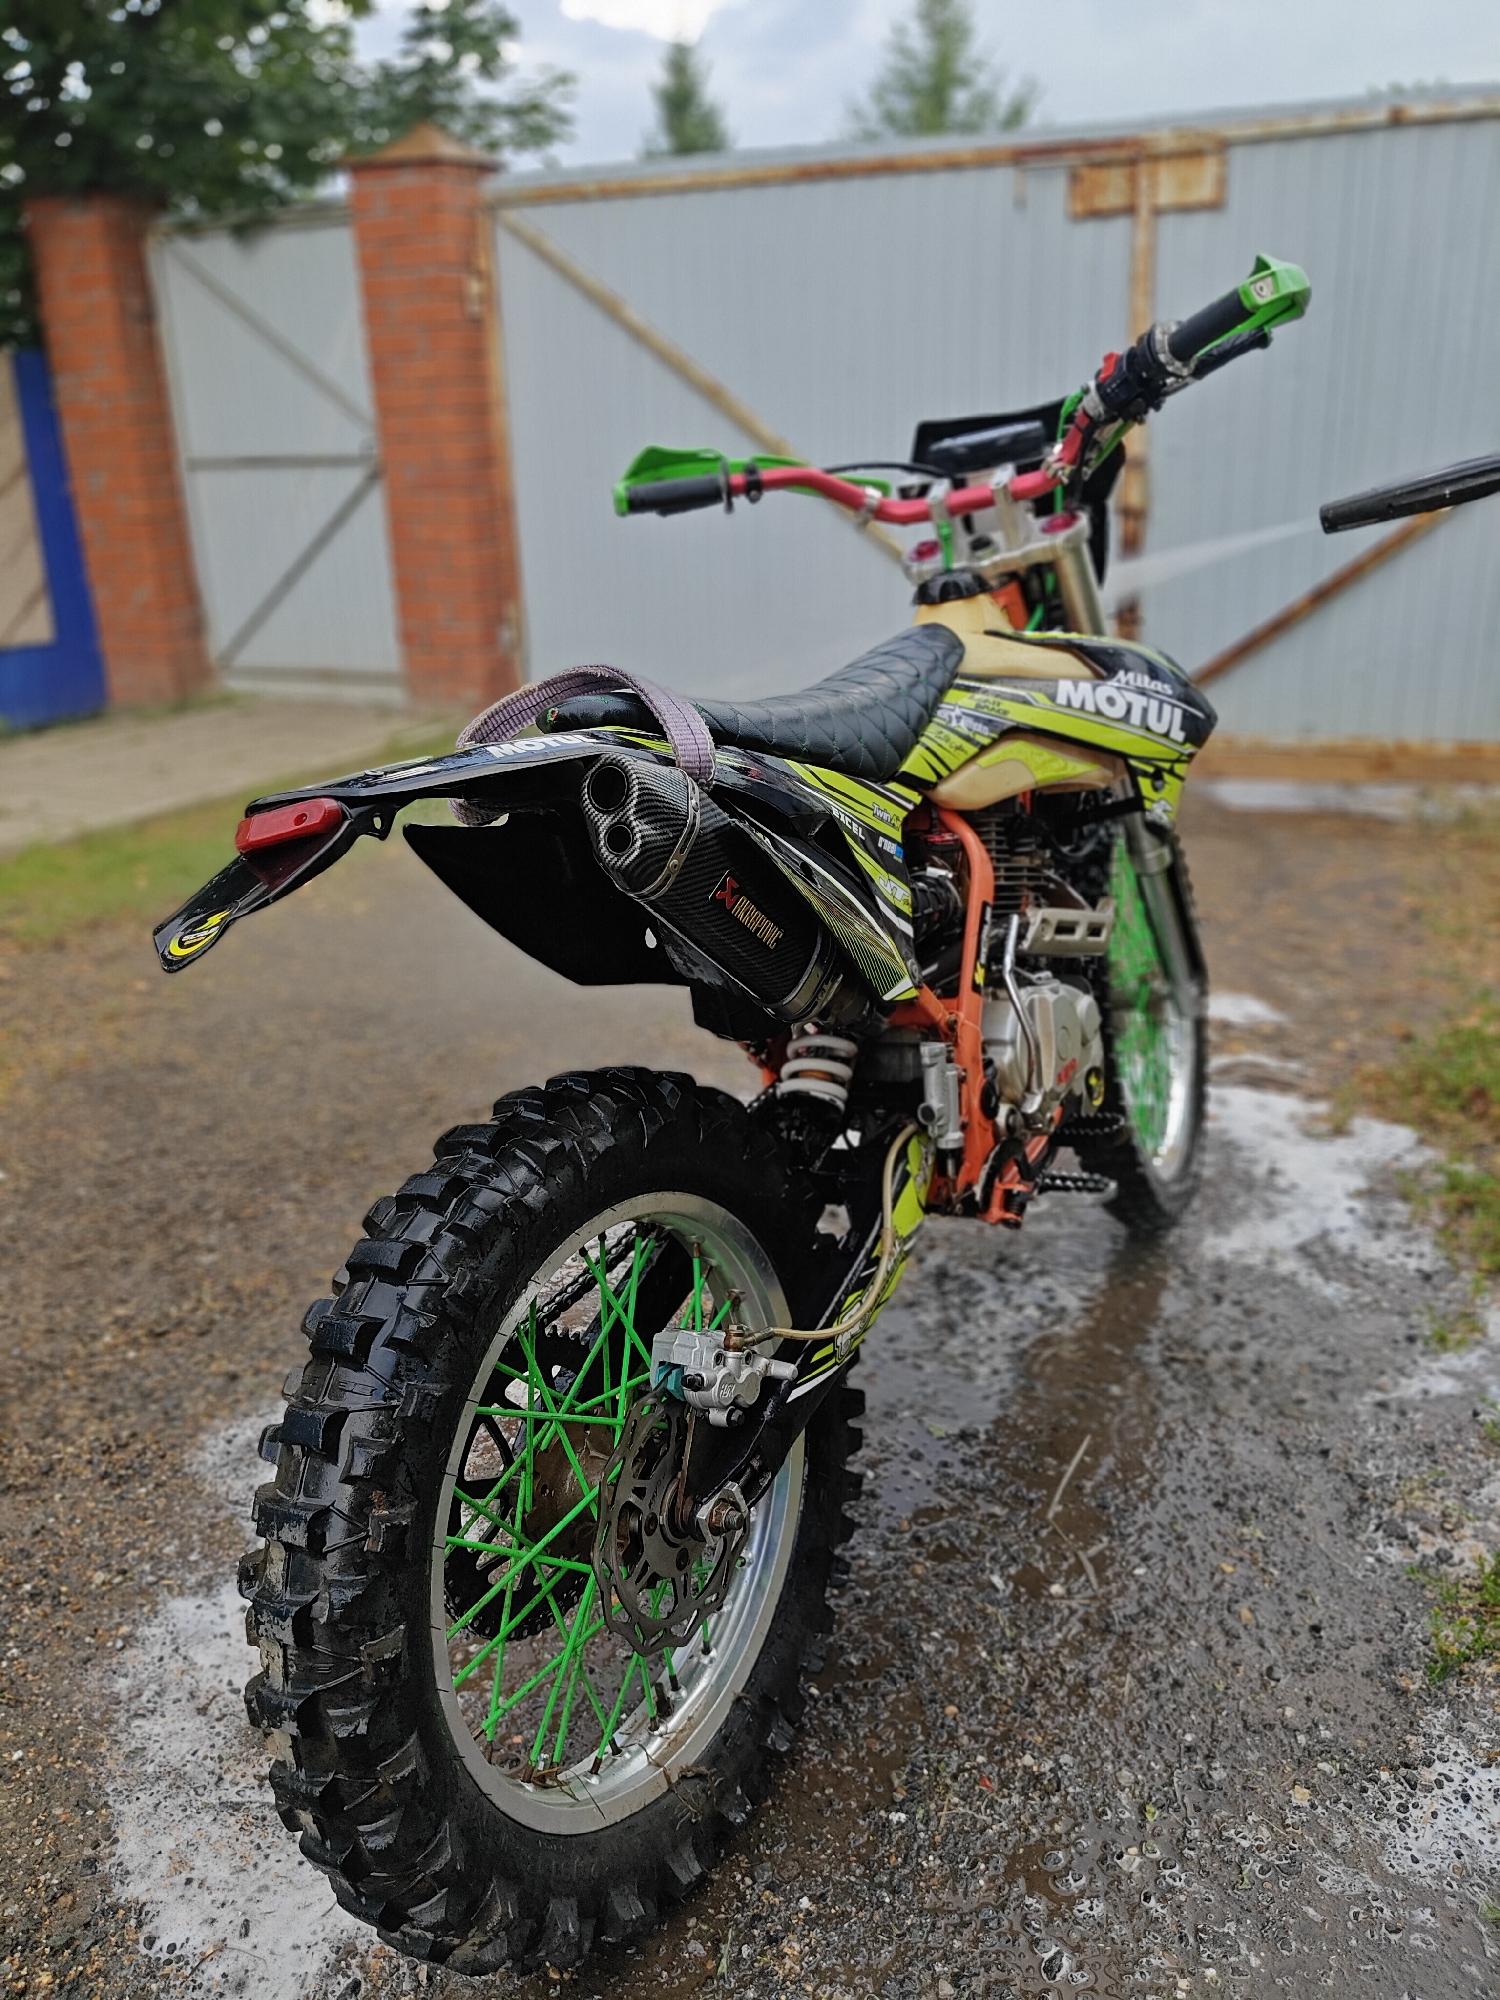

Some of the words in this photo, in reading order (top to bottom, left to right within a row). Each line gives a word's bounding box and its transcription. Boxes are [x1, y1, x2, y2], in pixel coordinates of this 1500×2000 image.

[1107, 669, 1174, 696] Mitas
[1055, 679, 1187, 743] MOTUL
[484, 734, 599, 759] MOTUL
[831, 806, 866, 841] EXCEL
